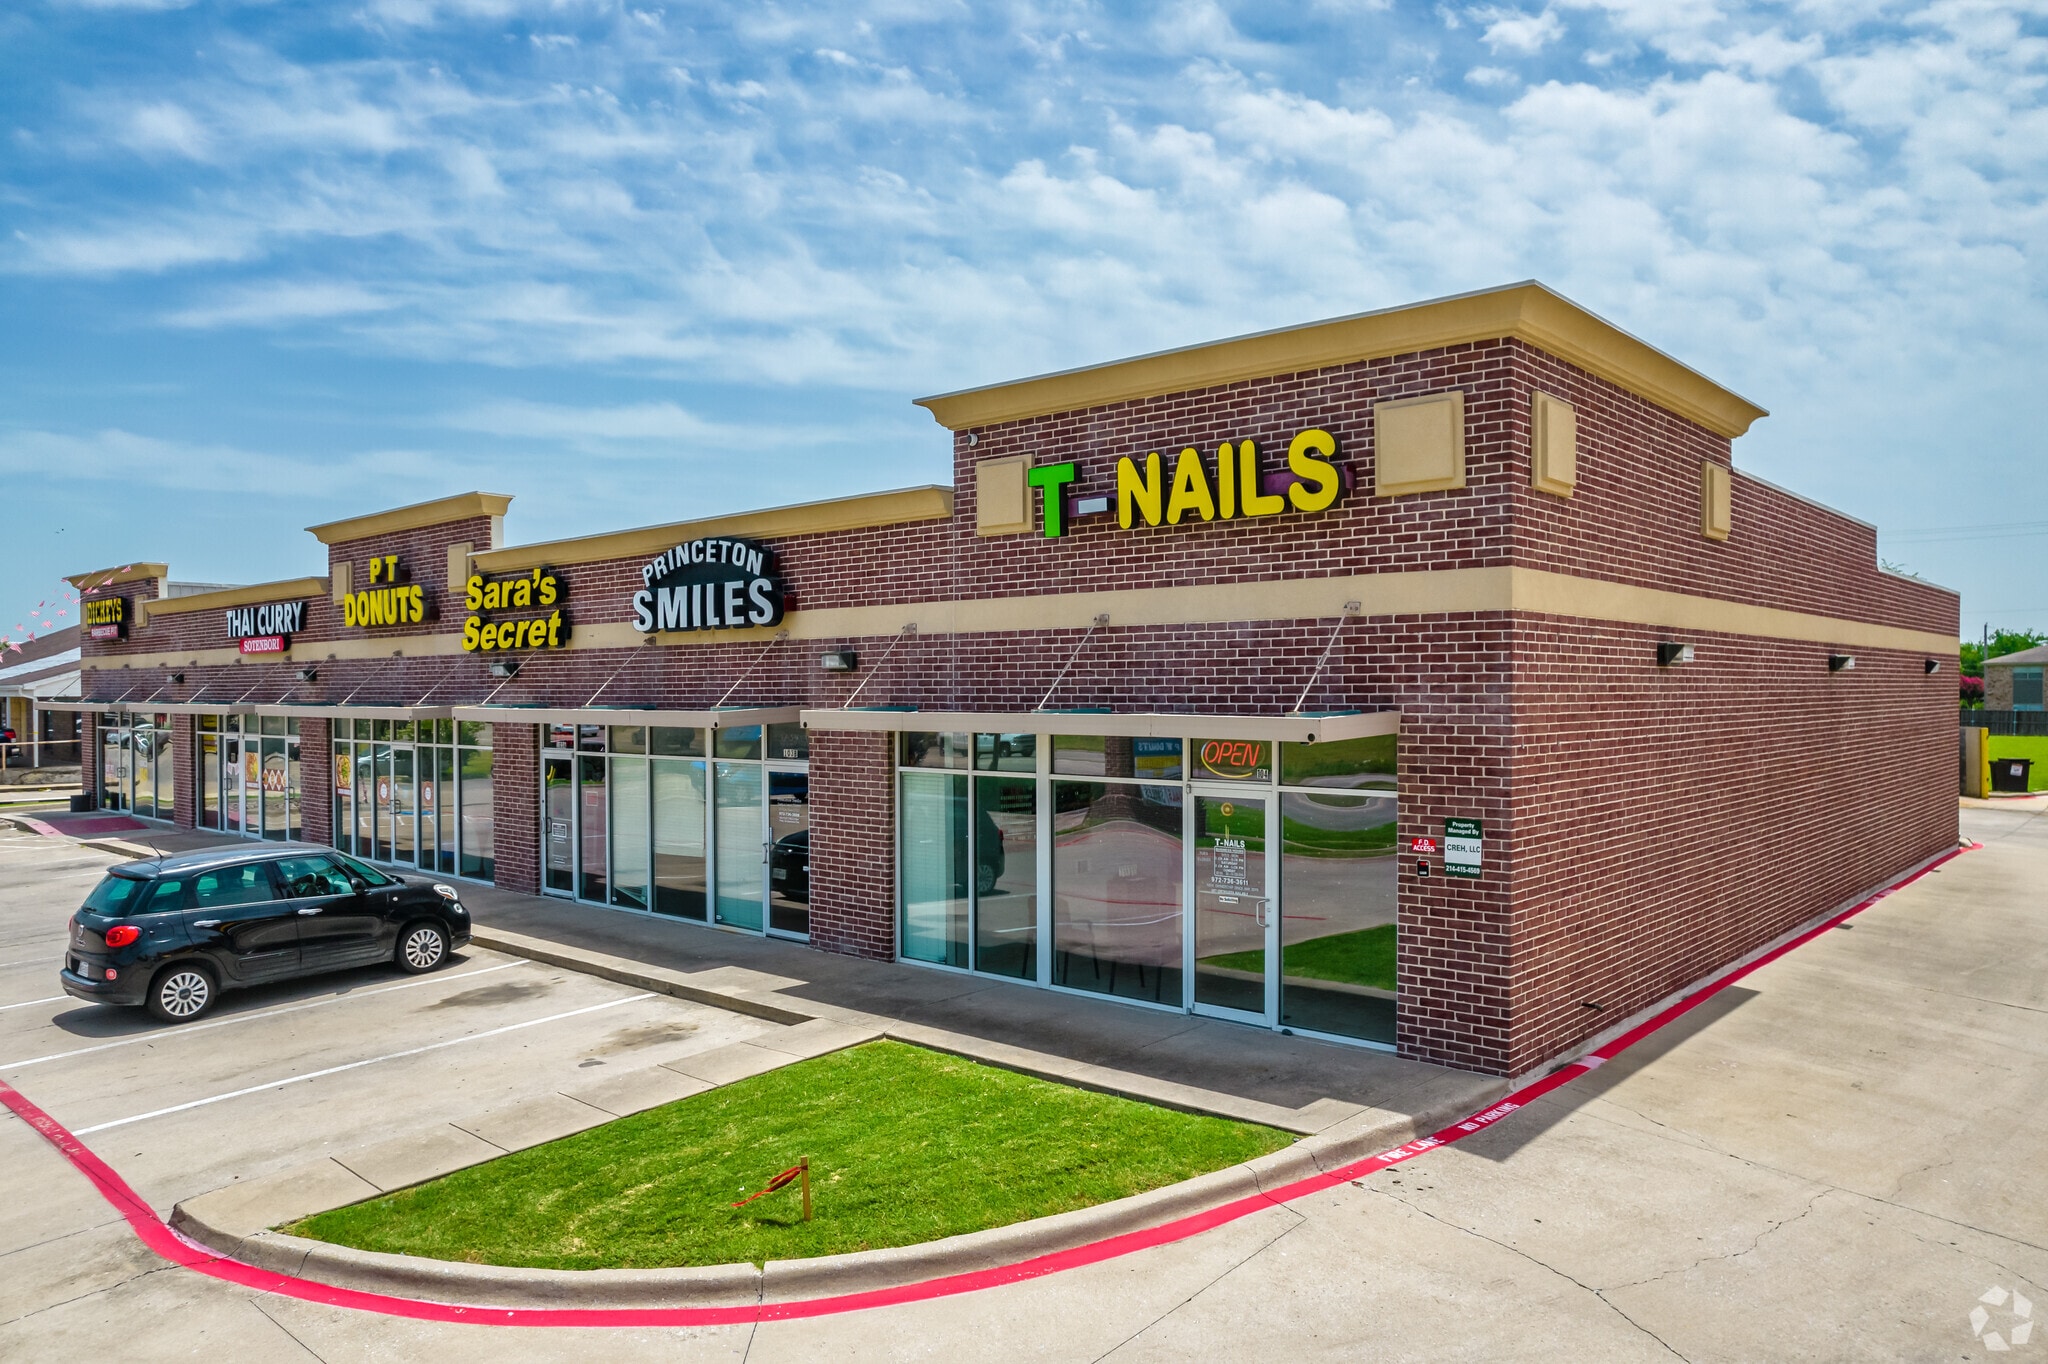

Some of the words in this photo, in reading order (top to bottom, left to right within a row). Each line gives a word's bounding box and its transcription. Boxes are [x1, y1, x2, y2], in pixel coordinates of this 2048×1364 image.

[369, 557, 382, 584] P
[386, 555, 398, 582] T
[642, 539, 763, 587] PRINCETON
[465, 568, 557, 611] Sara's
[345, 585, 424, 627] DONUTS
[632, 578, 774, 632] SMILES
[226, 607, 254, 638] THAI
[257, 602, 302, 636] CURRY
[462, 610, 561, 651] Secret
[243, 639, 280, 652] SOTENBORI
[1205, 741, 1260, 767] OPEN
[1447, 827, 1471, 835] Managed
[1452, 821, 1475, 829] Property
[1214, 838, 1246, 848] T-NAILS
[1412, 844, 1435, 852] ACCESS
[1446, 843, 1468, 853] CREH,
[1469, 845, 1481, 853] LLC
[1211, 876, 1249, 886] 972-736-3611
[1458, 1121, 1480, 1132] NO
[1475, 1102, 1520, 1123] PARKING
[1377, 1148, 1413, 1162] FIRE
[1408, 1136, 1445, 1151] LANE
